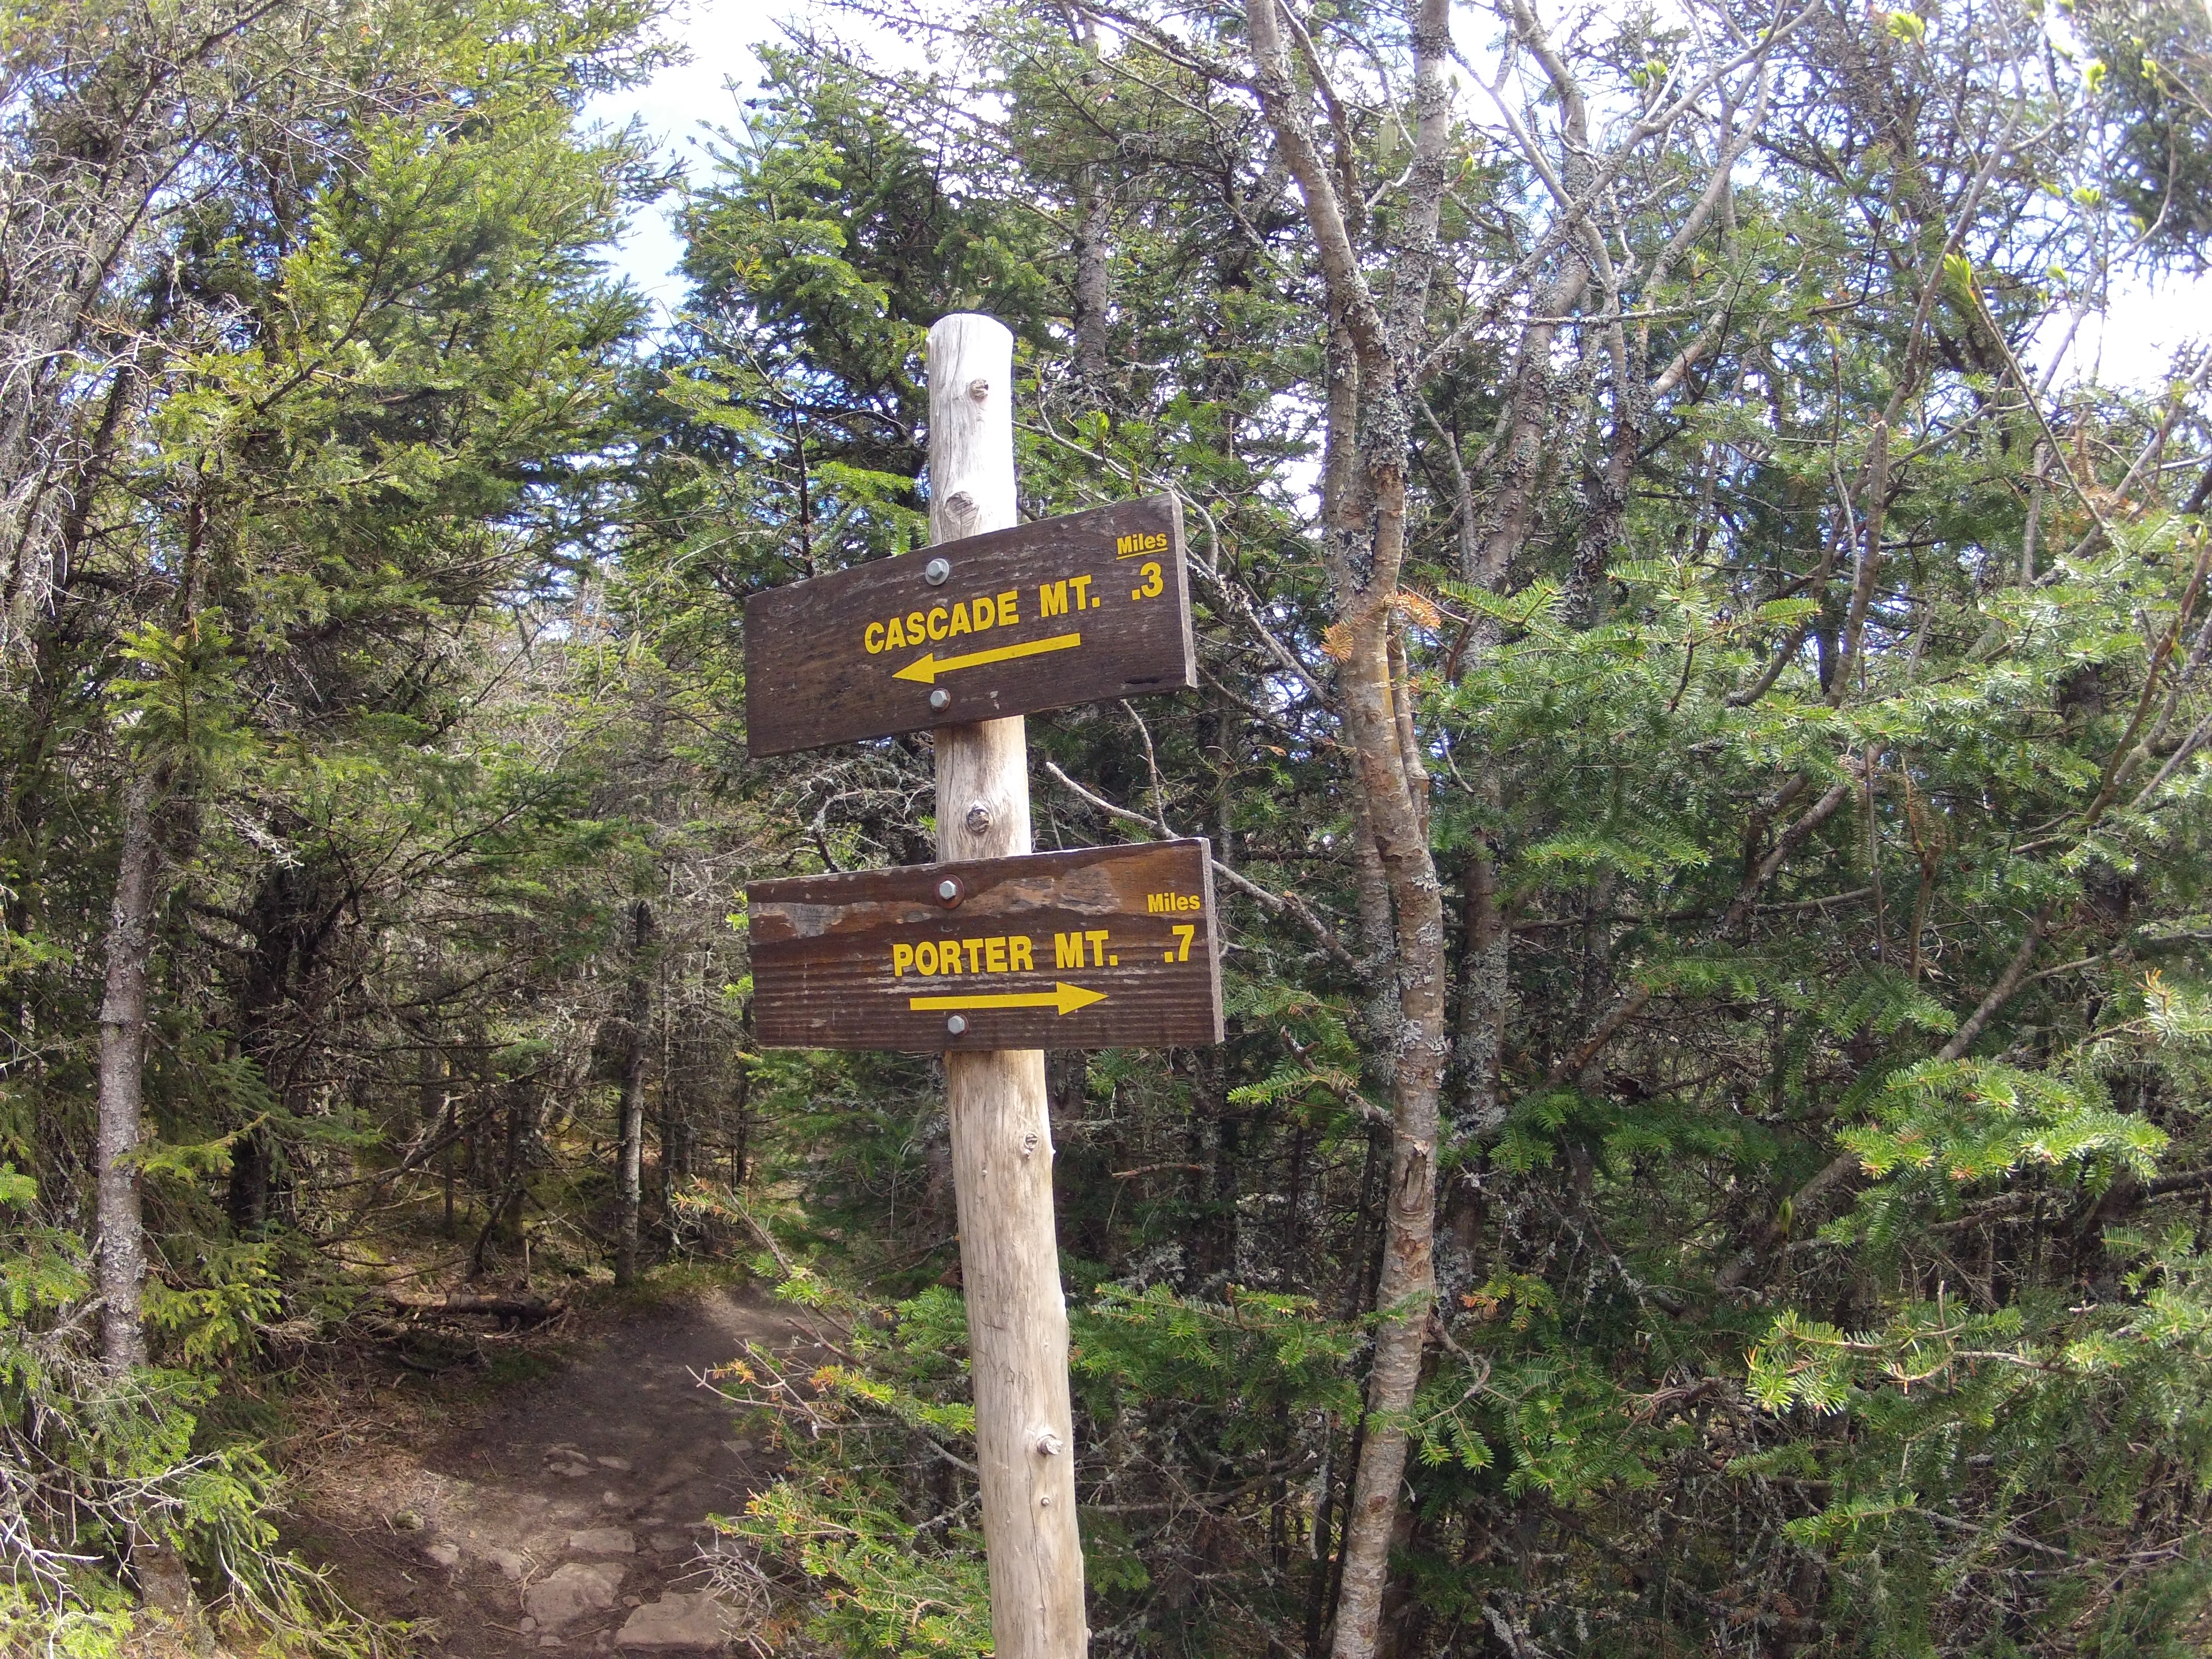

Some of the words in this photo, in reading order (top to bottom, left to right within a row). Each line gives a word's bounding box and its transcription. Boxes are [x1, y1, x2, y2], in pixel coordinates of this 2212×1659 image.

[1116, 533, 1168, 555] Miles
[865, 590, 1020, 655] CASCADE
[1039, 574, 1100, 618] MT.
[1131, 562, 1164, 601] .3
[1147, 892, 1201, 913] Miles
[893, 935, 1035, 978] PORTER
[1054, 930, 1119, 969] MT.
[1164, 924, 1195, 963] .7
